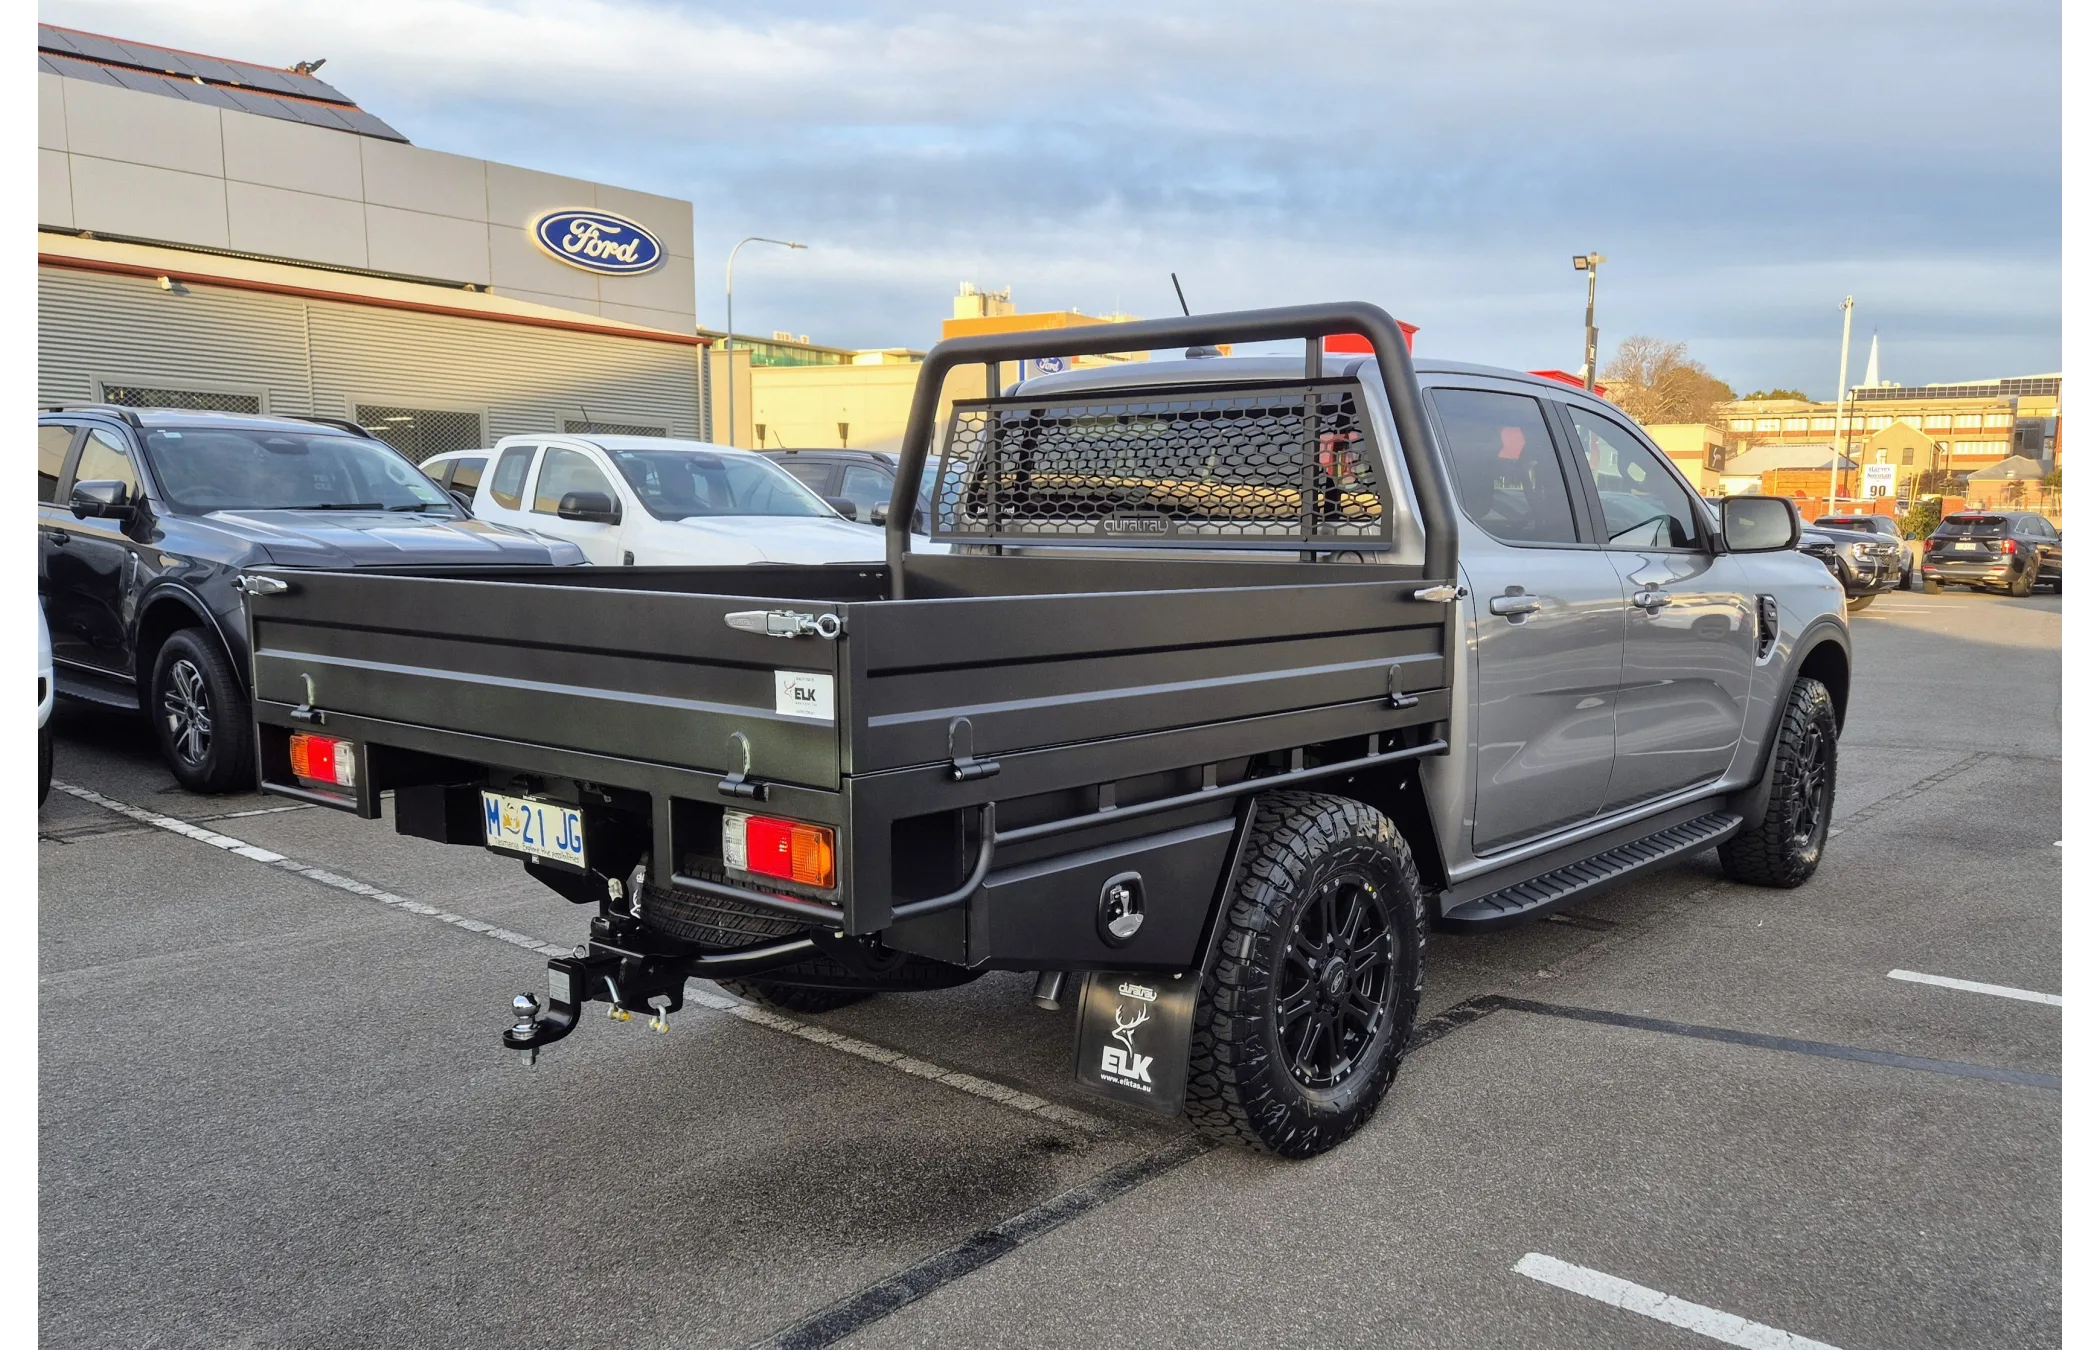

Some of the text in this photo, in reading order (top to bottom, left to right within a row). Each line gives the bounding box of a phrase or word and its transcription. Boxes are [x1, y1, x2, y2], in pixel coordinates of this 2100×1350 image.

[562, 219, 639, 263] Ford
[1039, 357, 1059, 371] Ford
[1870, 485, 1886, 497] 90
[795, 687, 816, 701] ELK
[485, 797, 581, 853] M 21 JG
[494, 837, 519, 849] Tasmania
[522, 843, 541, 854] Explore
[541, 847, 551, 857] the
[551, 851, 580, 863] possibilities
[1118, 982, 1157, 1001] duratray
[1101, 1045, 1154, 1083] ELK
[1100, 1073, 1151, 1092] www.elktas.au
